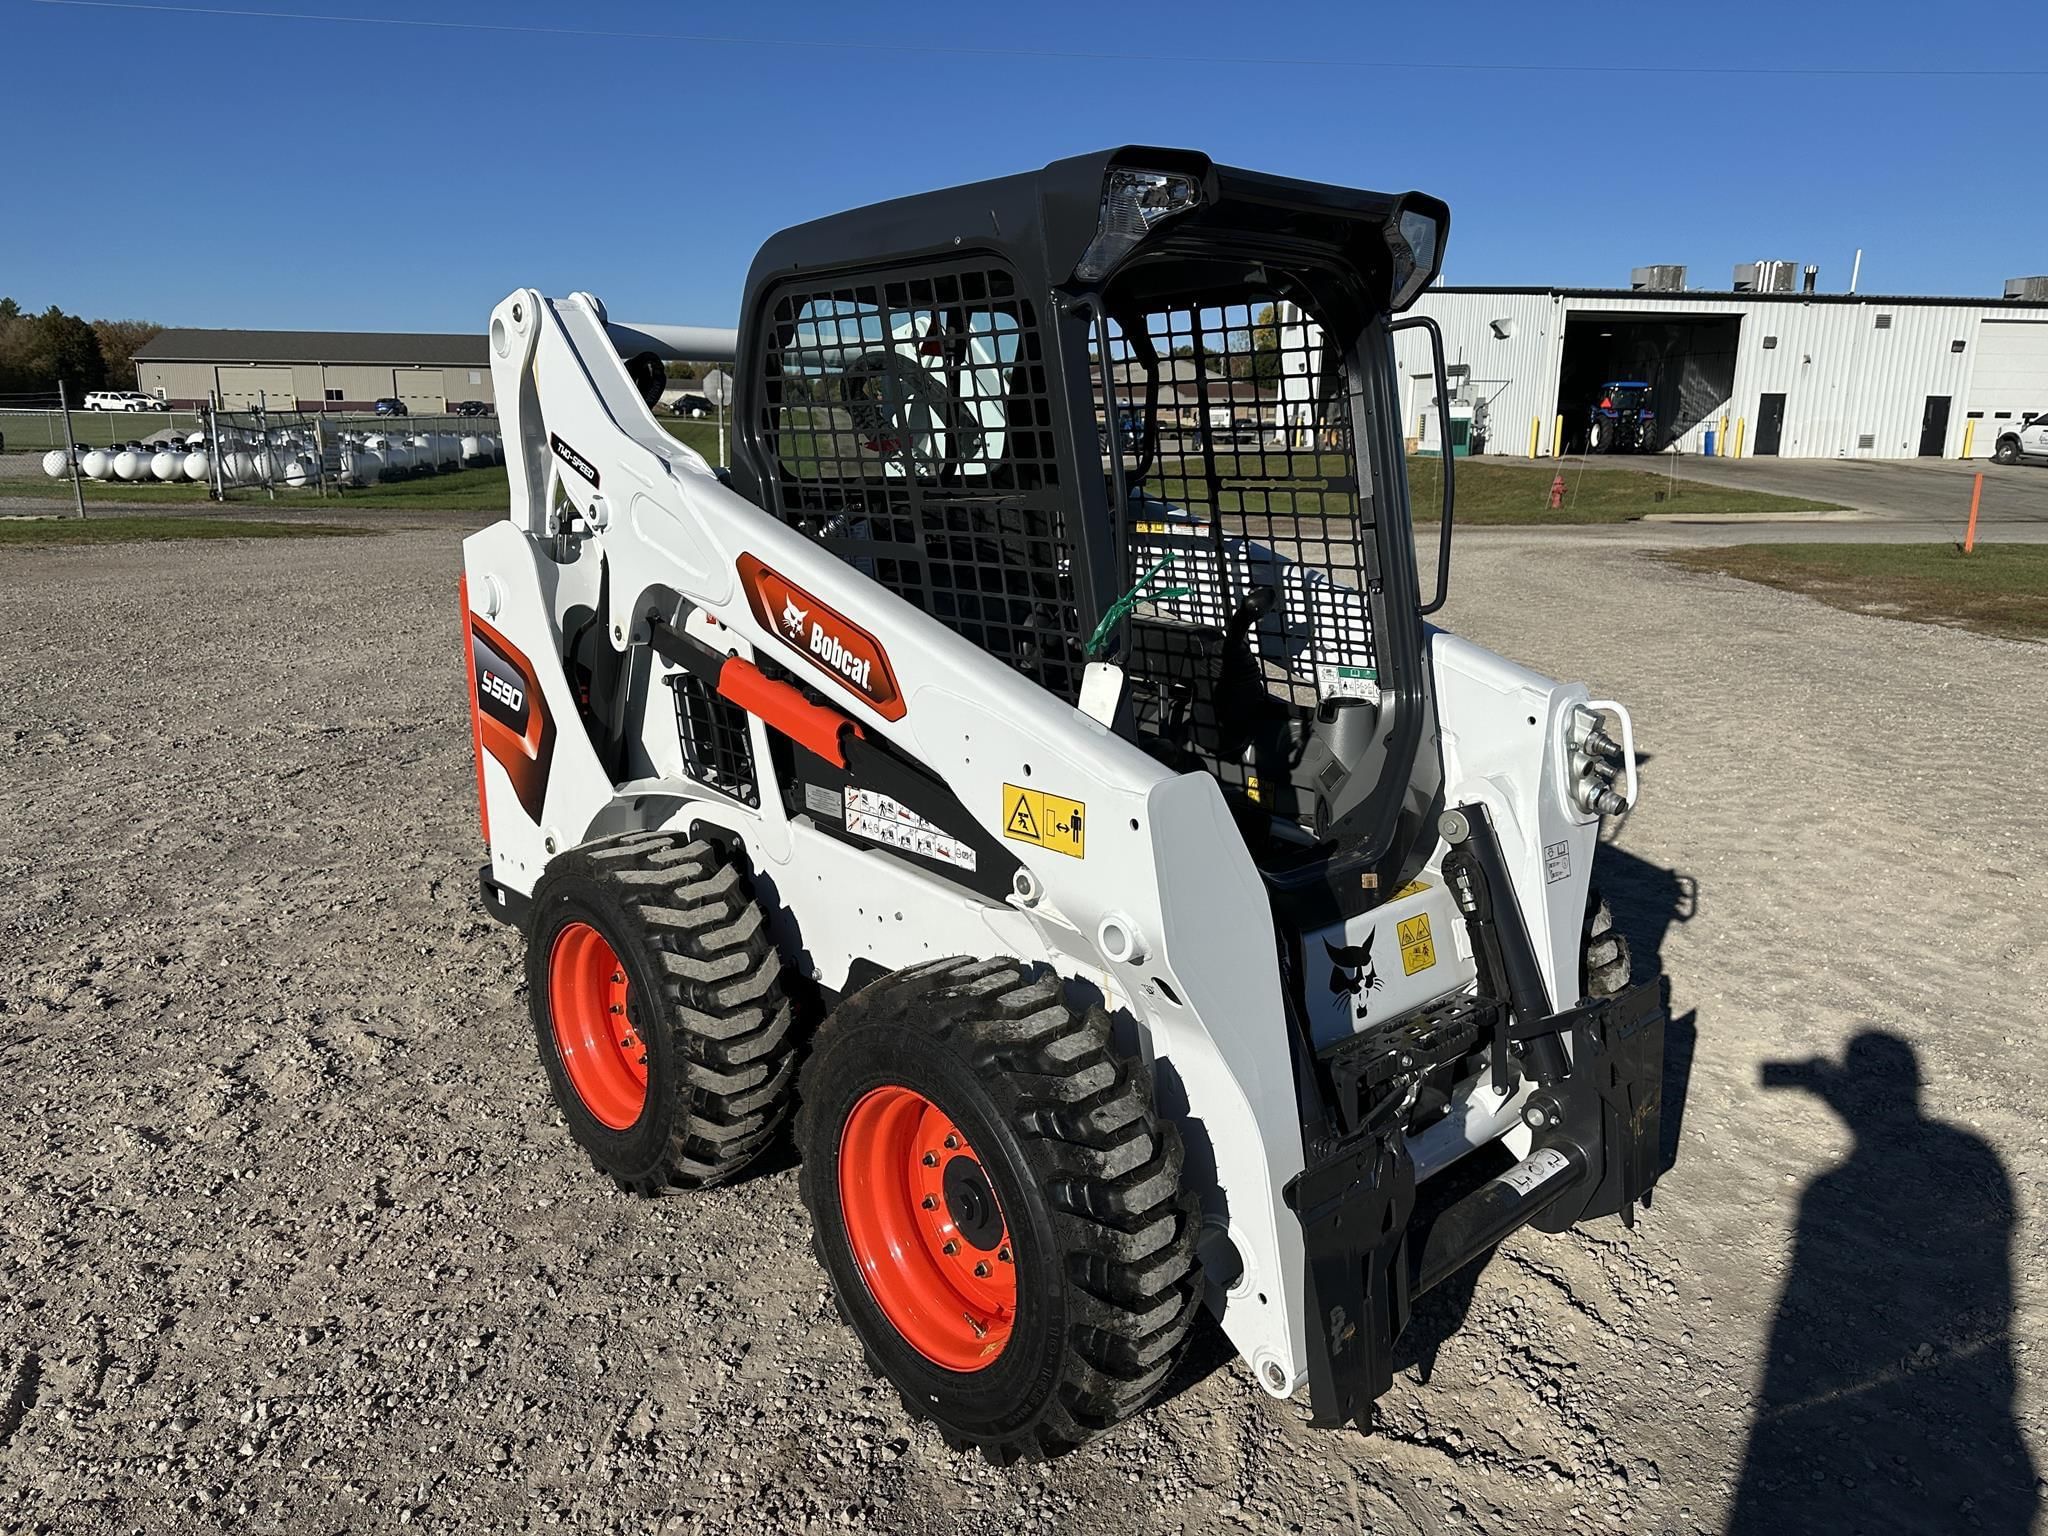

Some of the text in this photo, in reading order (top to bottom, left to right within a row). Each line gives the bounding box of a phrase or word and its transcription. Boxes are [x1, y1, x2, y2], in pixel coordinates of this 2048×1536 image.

[558, 442, 594, 479] TWO-SPEED
[810, 621, 871, 690] Bobcat
[481, 670, 523, 711] S590
